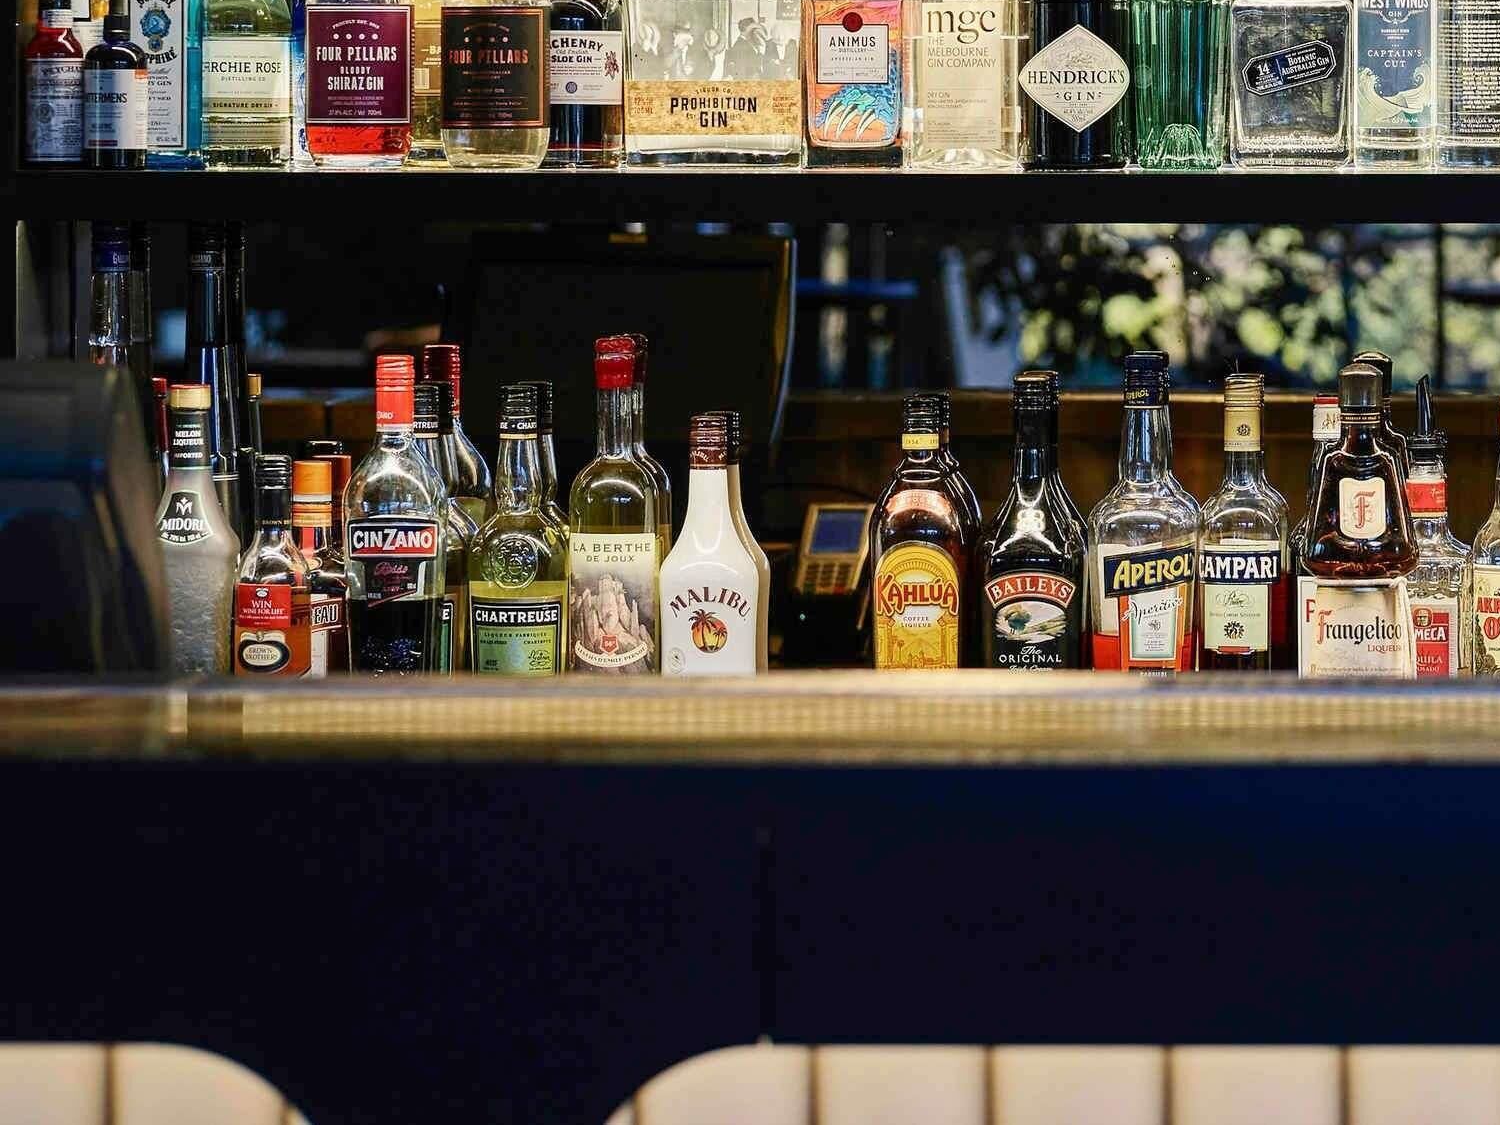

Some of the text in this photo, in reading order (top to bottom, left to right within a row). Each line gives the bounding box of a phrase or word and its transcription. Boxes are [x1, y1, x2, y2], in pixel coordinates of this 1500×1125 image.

[927, 9, 997, 45] mgc
[829, 36, 877, 48] ANIMUS
[927, 36, 945, 46] THE
[316, 46, 397, 61] FOUR PILLARS
[449, 49, 529, 64] FOUR PILLARS
[927, 47, 989, 57] MELBOURNE
[1367, 48, 1423, 58] CAPTAIN'S
[551, 55, 593, 63] SLOE GIN
[927, 58, 997, 68] GIN COMPANY
[1384, 59, 1407, 68] CUT
[255, 61, 282, 73] ROSE
[340, 66, 371, 75] BLOODY
[1256, 62, 1271, 76] 14
[327, 76, 384, 91] SHIRAZ GIN
[1027, 69, 1126, 85] HENDRICK'S
[1063, 91, 1096, 101] GIN
[670, 97, 758, 115] PROHIBITION
[699, 111, 728, 128] GIN
[175, 430, 201, 438] MELON
[172, 438, 205, 447] LIQUEUR
[160, 517, 205, 531] MIDORI
[353, 528, 436, 551] CINZANO
[573, 542, 651, 553] LA BERTHE
[586, 555, 635, 563] DE JOUX
[1113, 553, 1192, 590] APEROL
[1199, 555, 1279, 579] CAMPARI
[876, 572, 960, 616] KAHLÚA
[990, 578, 1072, 602] BAILEYS
[251, 600, 272, 609] WIN
[669, 586, 752, 619] MALIBU
[475, 607, 558, 623] CHARTREUSE
[1121, 595, 1184, 625] Aperitivo
[1316, 609, 1403, 646] Frangelico
[1020, 645, 1042, 656] The
[999, 654, 1062, 663] ORIGINAL
[1416, 656, 1443, 665] QUILA
